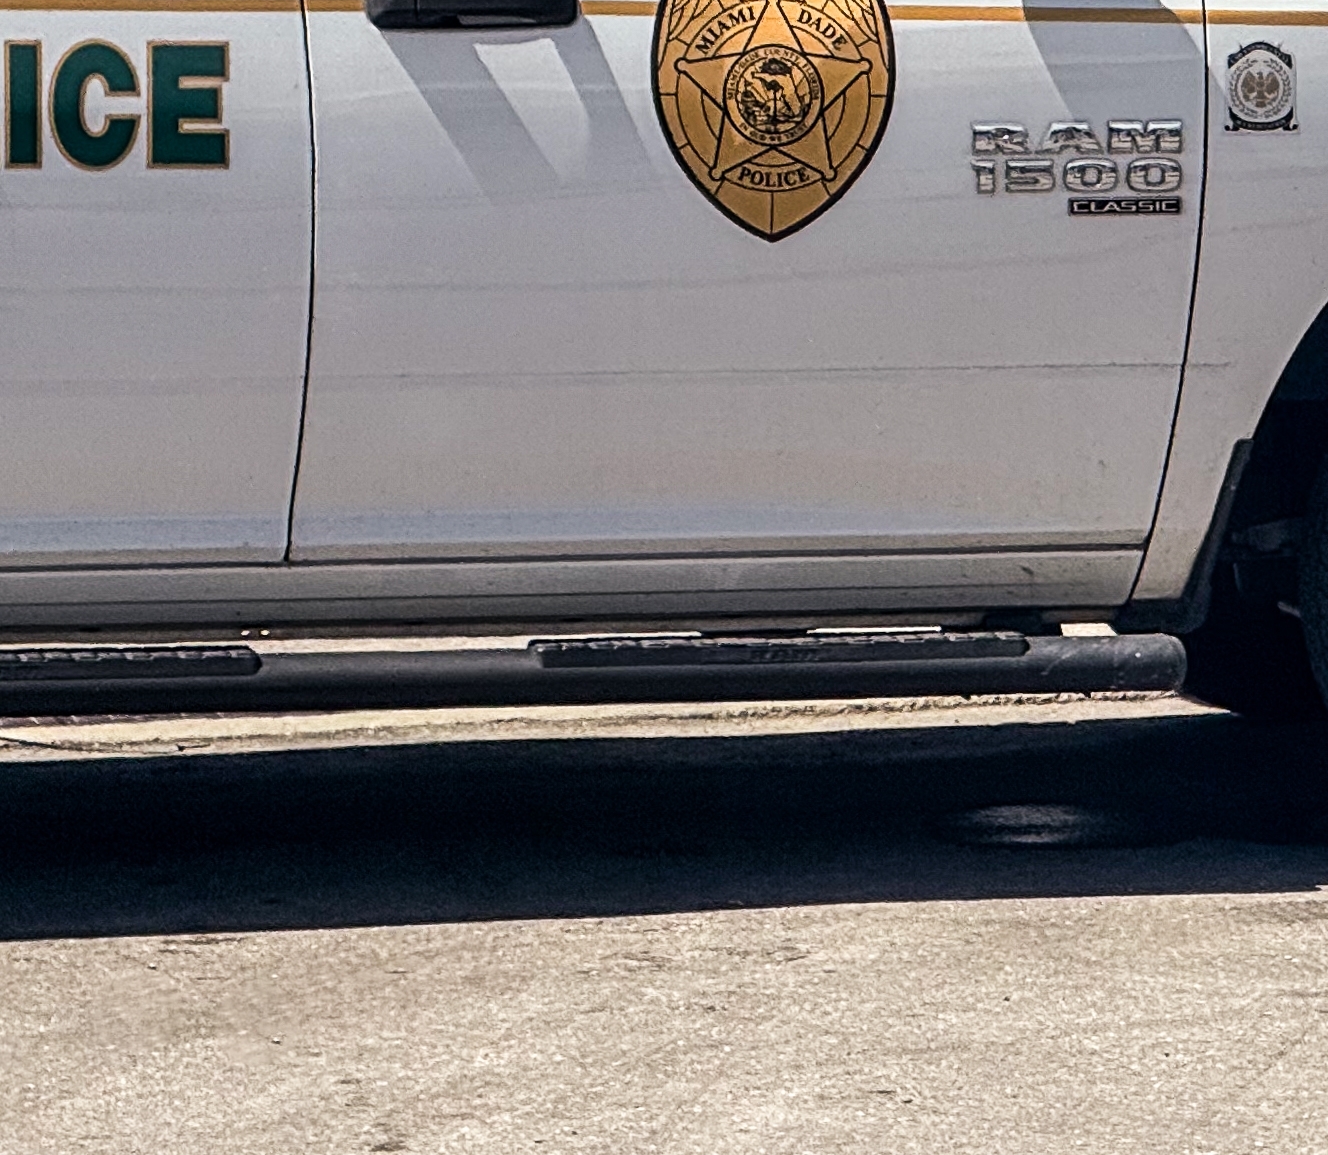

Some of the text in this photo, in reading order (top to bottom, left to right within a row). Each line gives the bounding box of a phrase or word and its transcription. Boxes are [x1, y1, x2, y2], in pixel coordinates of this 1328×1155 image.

[695, 5, 850, 54] MIAMI DADE
[971, 120, 1184, 155] RAM
[737, 166, 811, 189] POLICE
[970, 157, 1183, 194] 1500
[1072, 200, 1179, 213] CLASSIC
